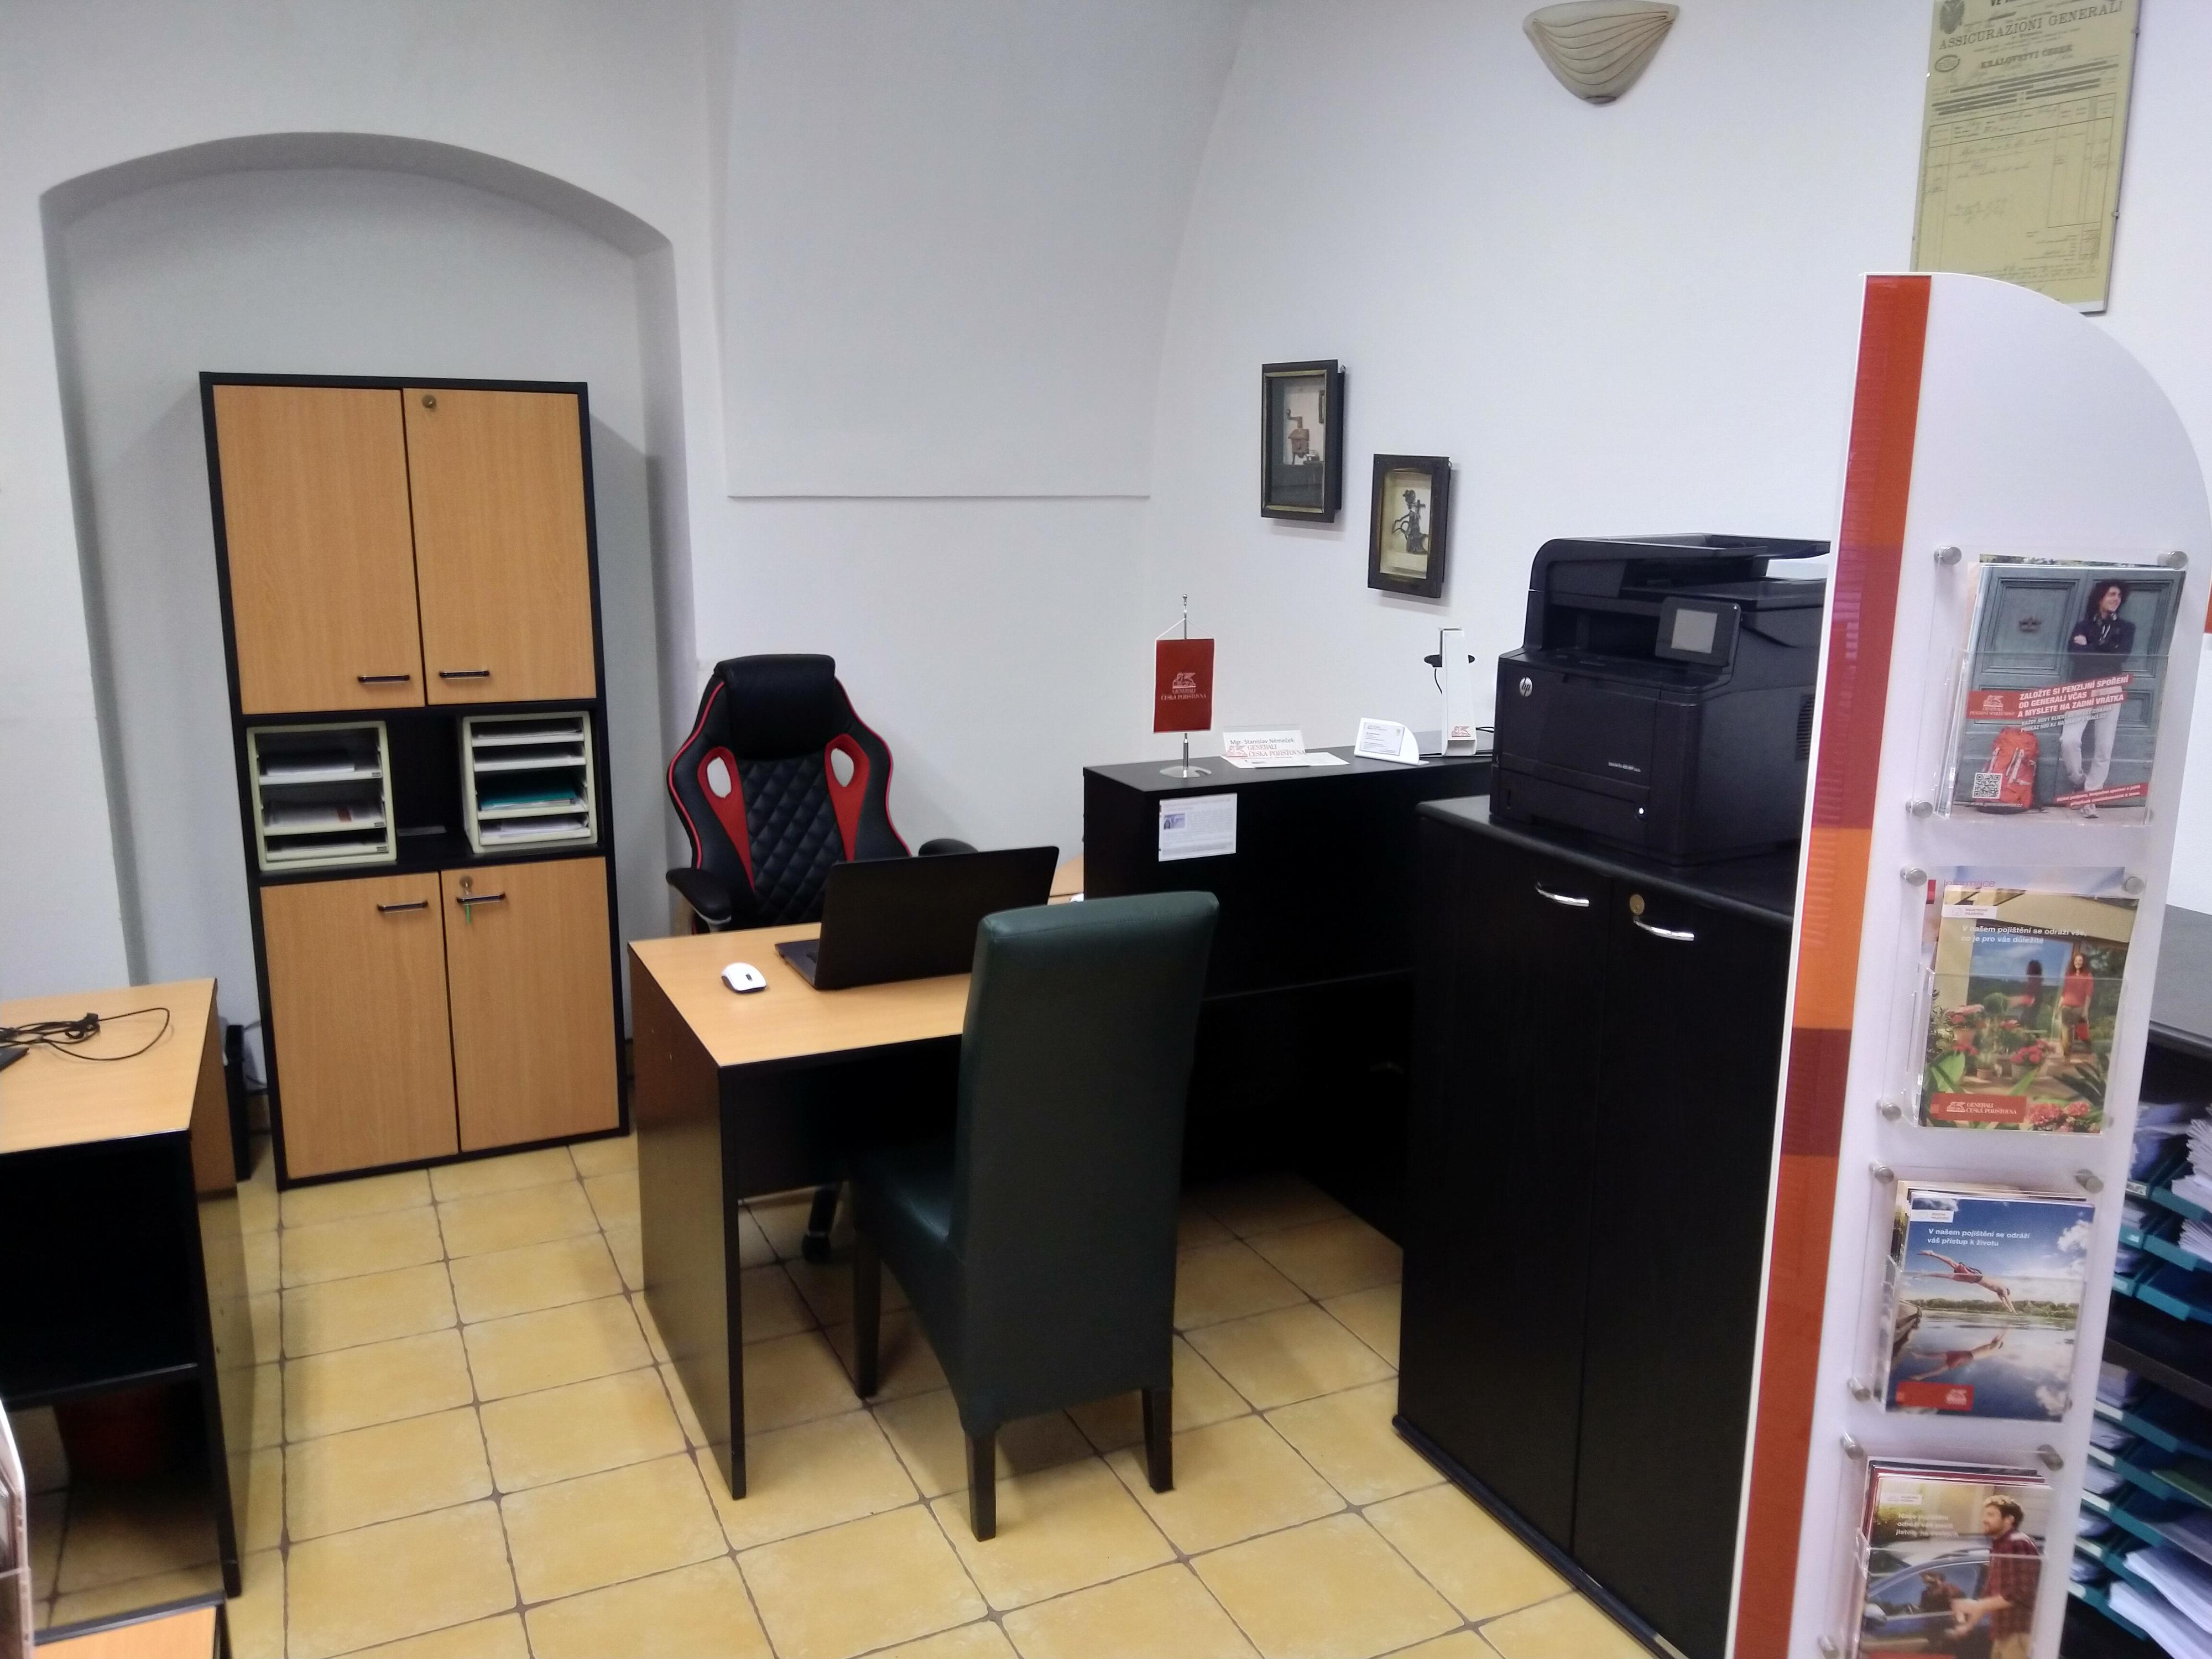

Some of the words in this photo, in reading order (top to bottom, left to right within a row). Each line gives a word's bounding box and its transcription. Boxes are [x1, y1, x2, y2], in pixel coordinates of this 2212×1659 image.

[1938, 18, 2043, 50] ASSICURAZIONI
[2048, 1, 2124, 27] GENERALI
[1521, 676, 1531, 697] hp
[2020, 688, 2051, 700] ZALOŽTE
[2052, 687, 2060, 696] SI
[2062, 681, 2095, 694] PENZIJNÍ
[2096, 674, 2129, 688] SPOŘENÍ
[2018, 701, 2030, 709] OD
[2031, 695, 2067, 707] GENERALI
[2068, 691, 2088, 702] VČAS
[2025, 706, 2058, 717] MYSLETE
[2059, 702, 2070, 711] NA
[2072, 698, 2094, 709] ZADNÍ
[2095, 693, 2124, 705] VRÁTKA
[1997, 926, 2031, 935] pojištění
[1961, 1229, 1994, 1238] pojištění
